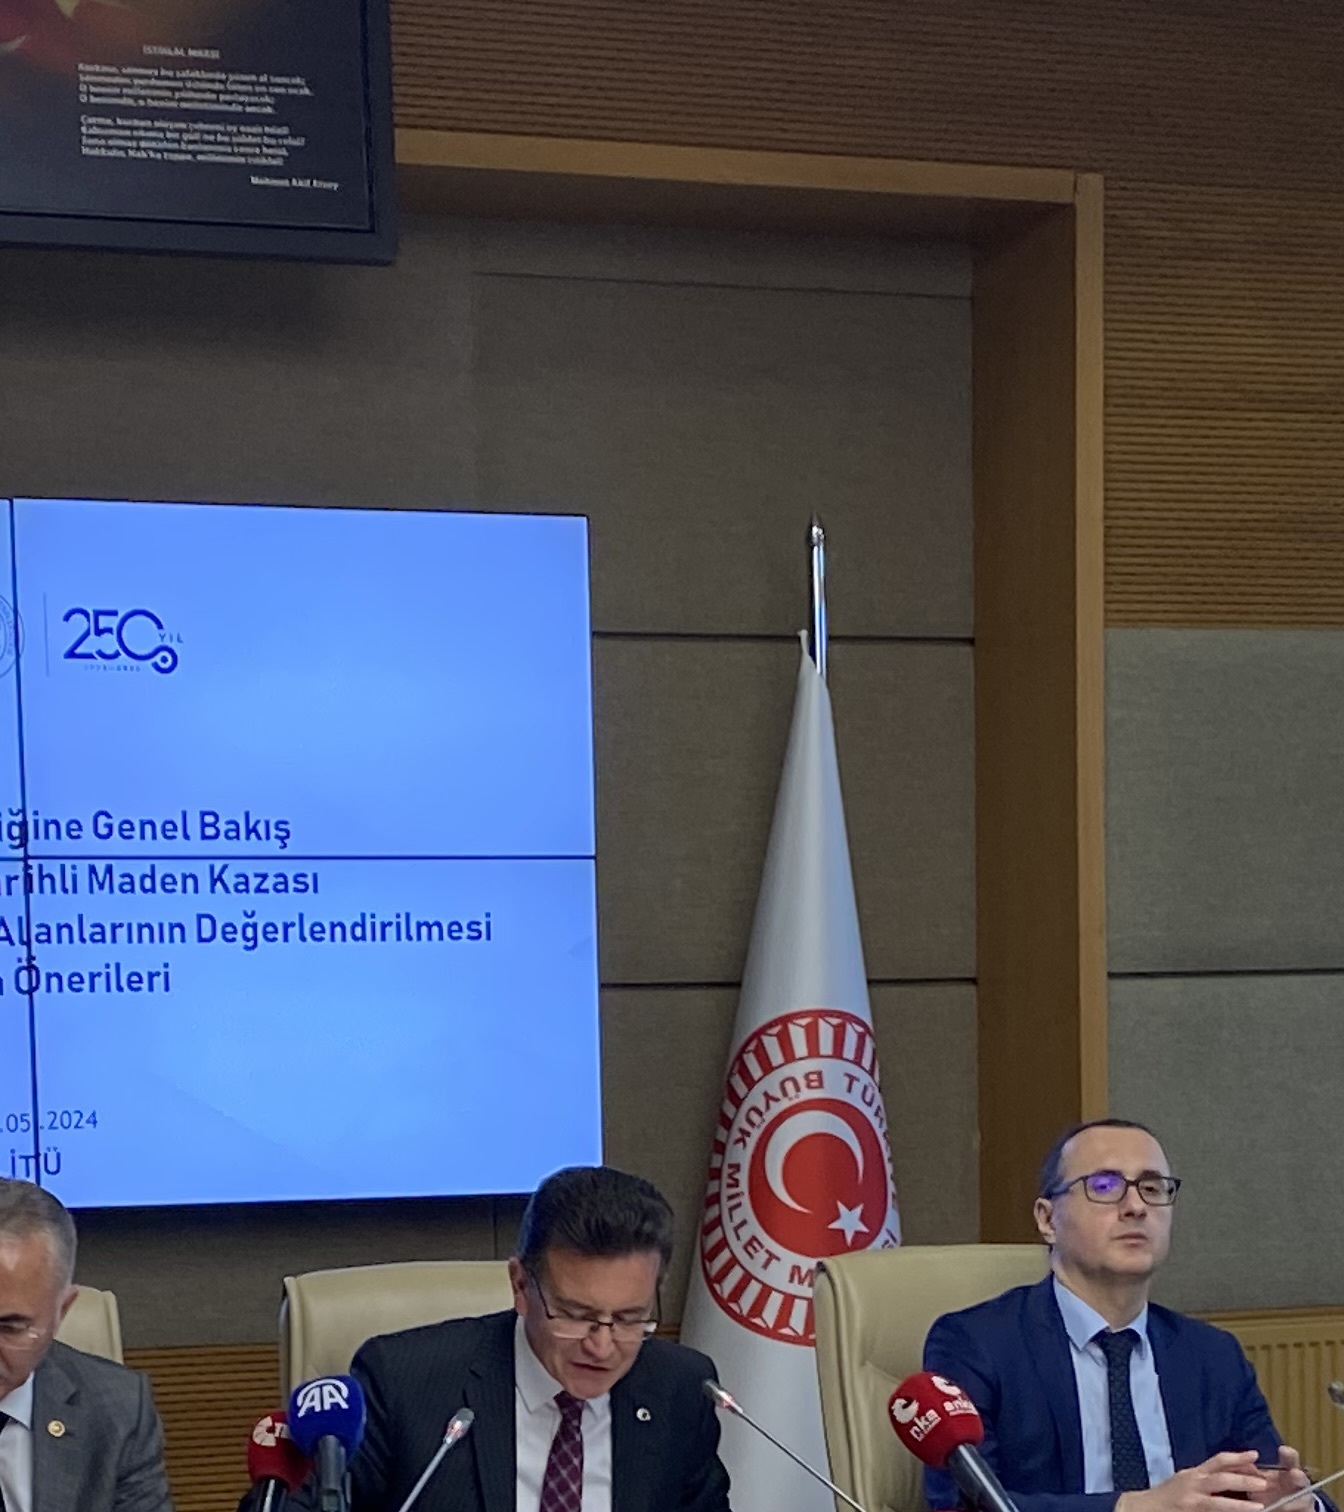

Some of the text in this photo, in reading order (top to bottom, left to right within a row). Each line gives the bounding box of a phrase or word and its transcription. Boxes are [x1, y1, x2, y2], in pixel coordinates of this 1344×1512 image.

[92, 809, 191, 841] Genel
[199, 809, 291, 849] Bakış
[88, 862, 200, 895] Maden
[208, 862, 320, 896] Kazası
[196, 909, 493, 951] Değerlendirilmesi
[14, 956, 171, 996] Önerileri
[10, 1146, 62, 1178] İTÜ
[725, 1069, 825, 1273] BÜYÜK MİLLET
[296, 1380, 350, 1418] AA
